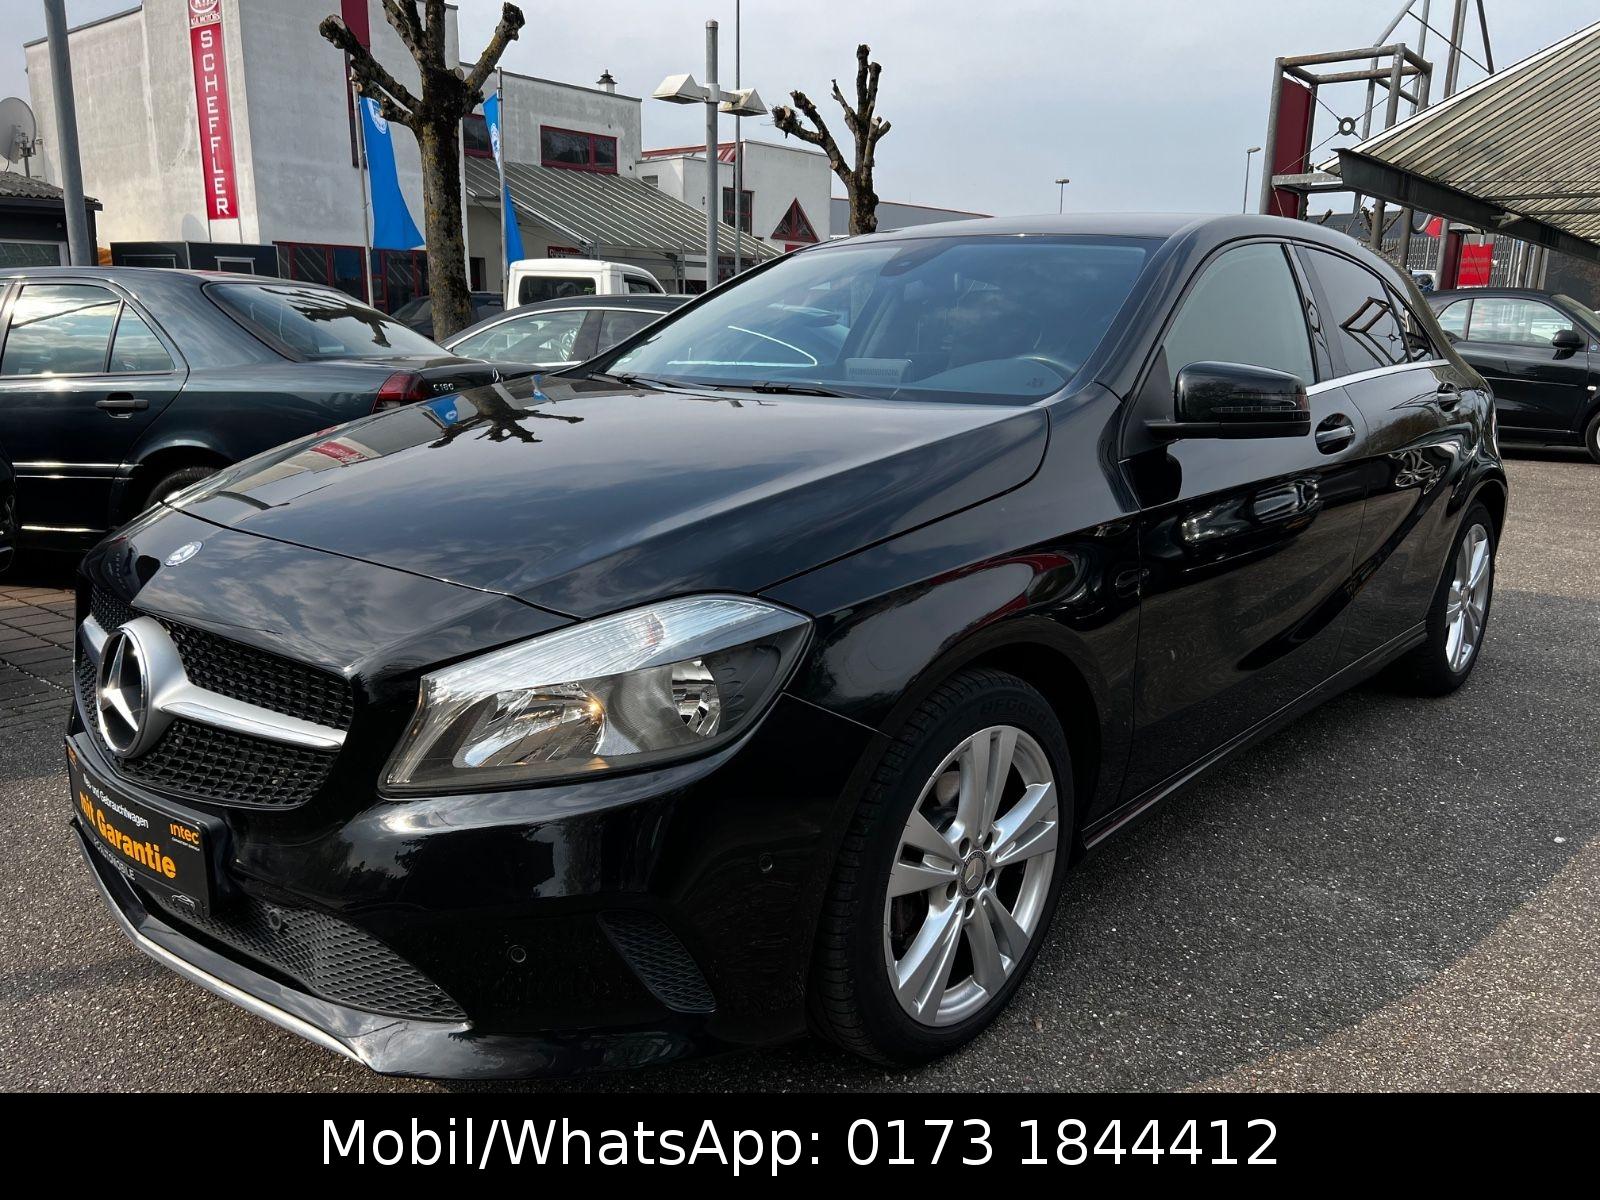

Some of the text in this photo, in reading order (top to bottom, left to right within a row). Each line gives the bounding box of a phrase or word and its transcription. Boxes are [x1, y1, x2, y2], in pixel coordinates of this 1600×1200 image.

[201, 30, 229, 215] SCHEFFLER
[79, 790, 177, 879] mit Garantie
[100, 791, 149, 829] Gebrauchtwagen
